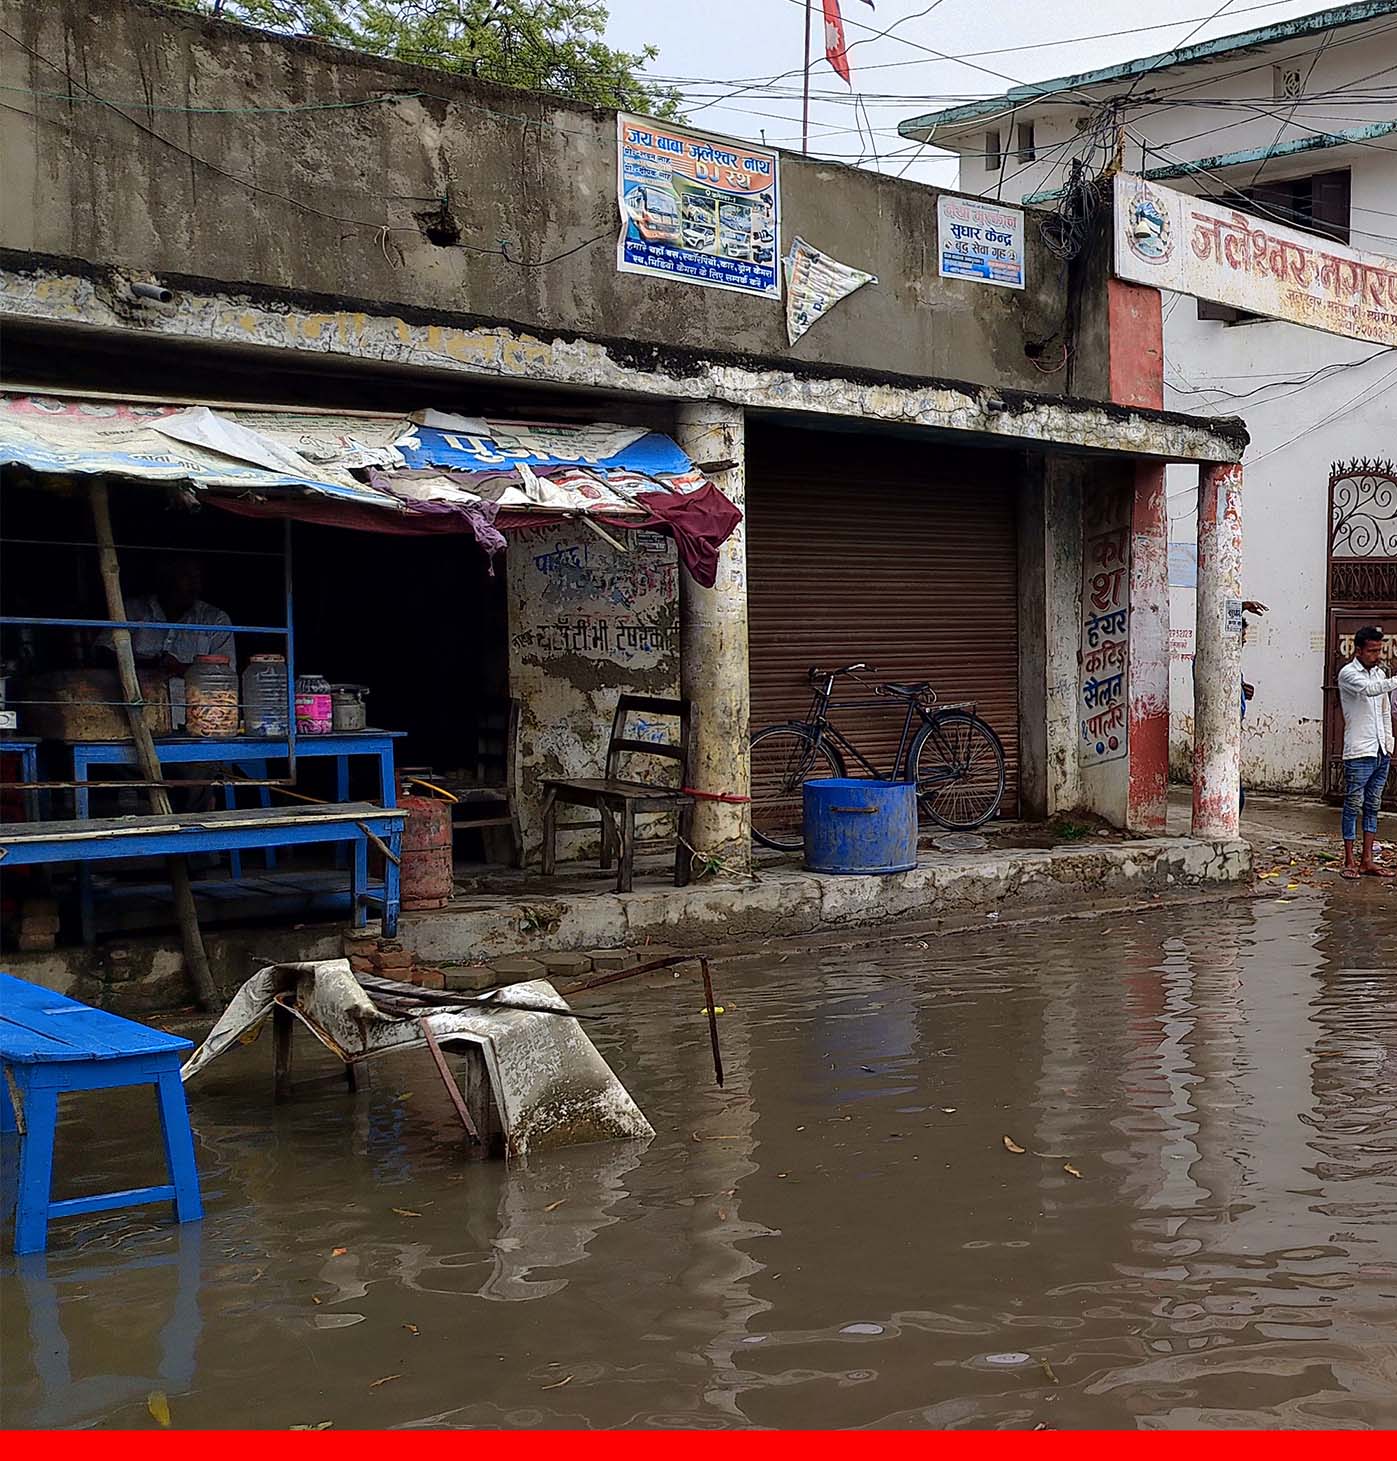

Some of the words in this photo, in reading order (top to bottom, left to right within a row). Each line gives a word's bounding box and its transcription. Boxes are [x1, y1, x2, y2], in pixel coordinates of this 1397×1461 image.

[626, 127, 652, 146] जय
[656, 135, 684, 154] बाबा
[688, 143, 738, 168] जलेश्वर
[742, 157, 770, 175] नाथ
[695, 161, 720, 182] DJ
[725, 170, 752, 190] रथ
[985, 227, 1013, 246] केन्द्र
[1190, 211, 1314, 290] जलेश्वर
[1084, 609, 1127, 648] हेयर
[1083, 672, 1125, 709] सैलून
